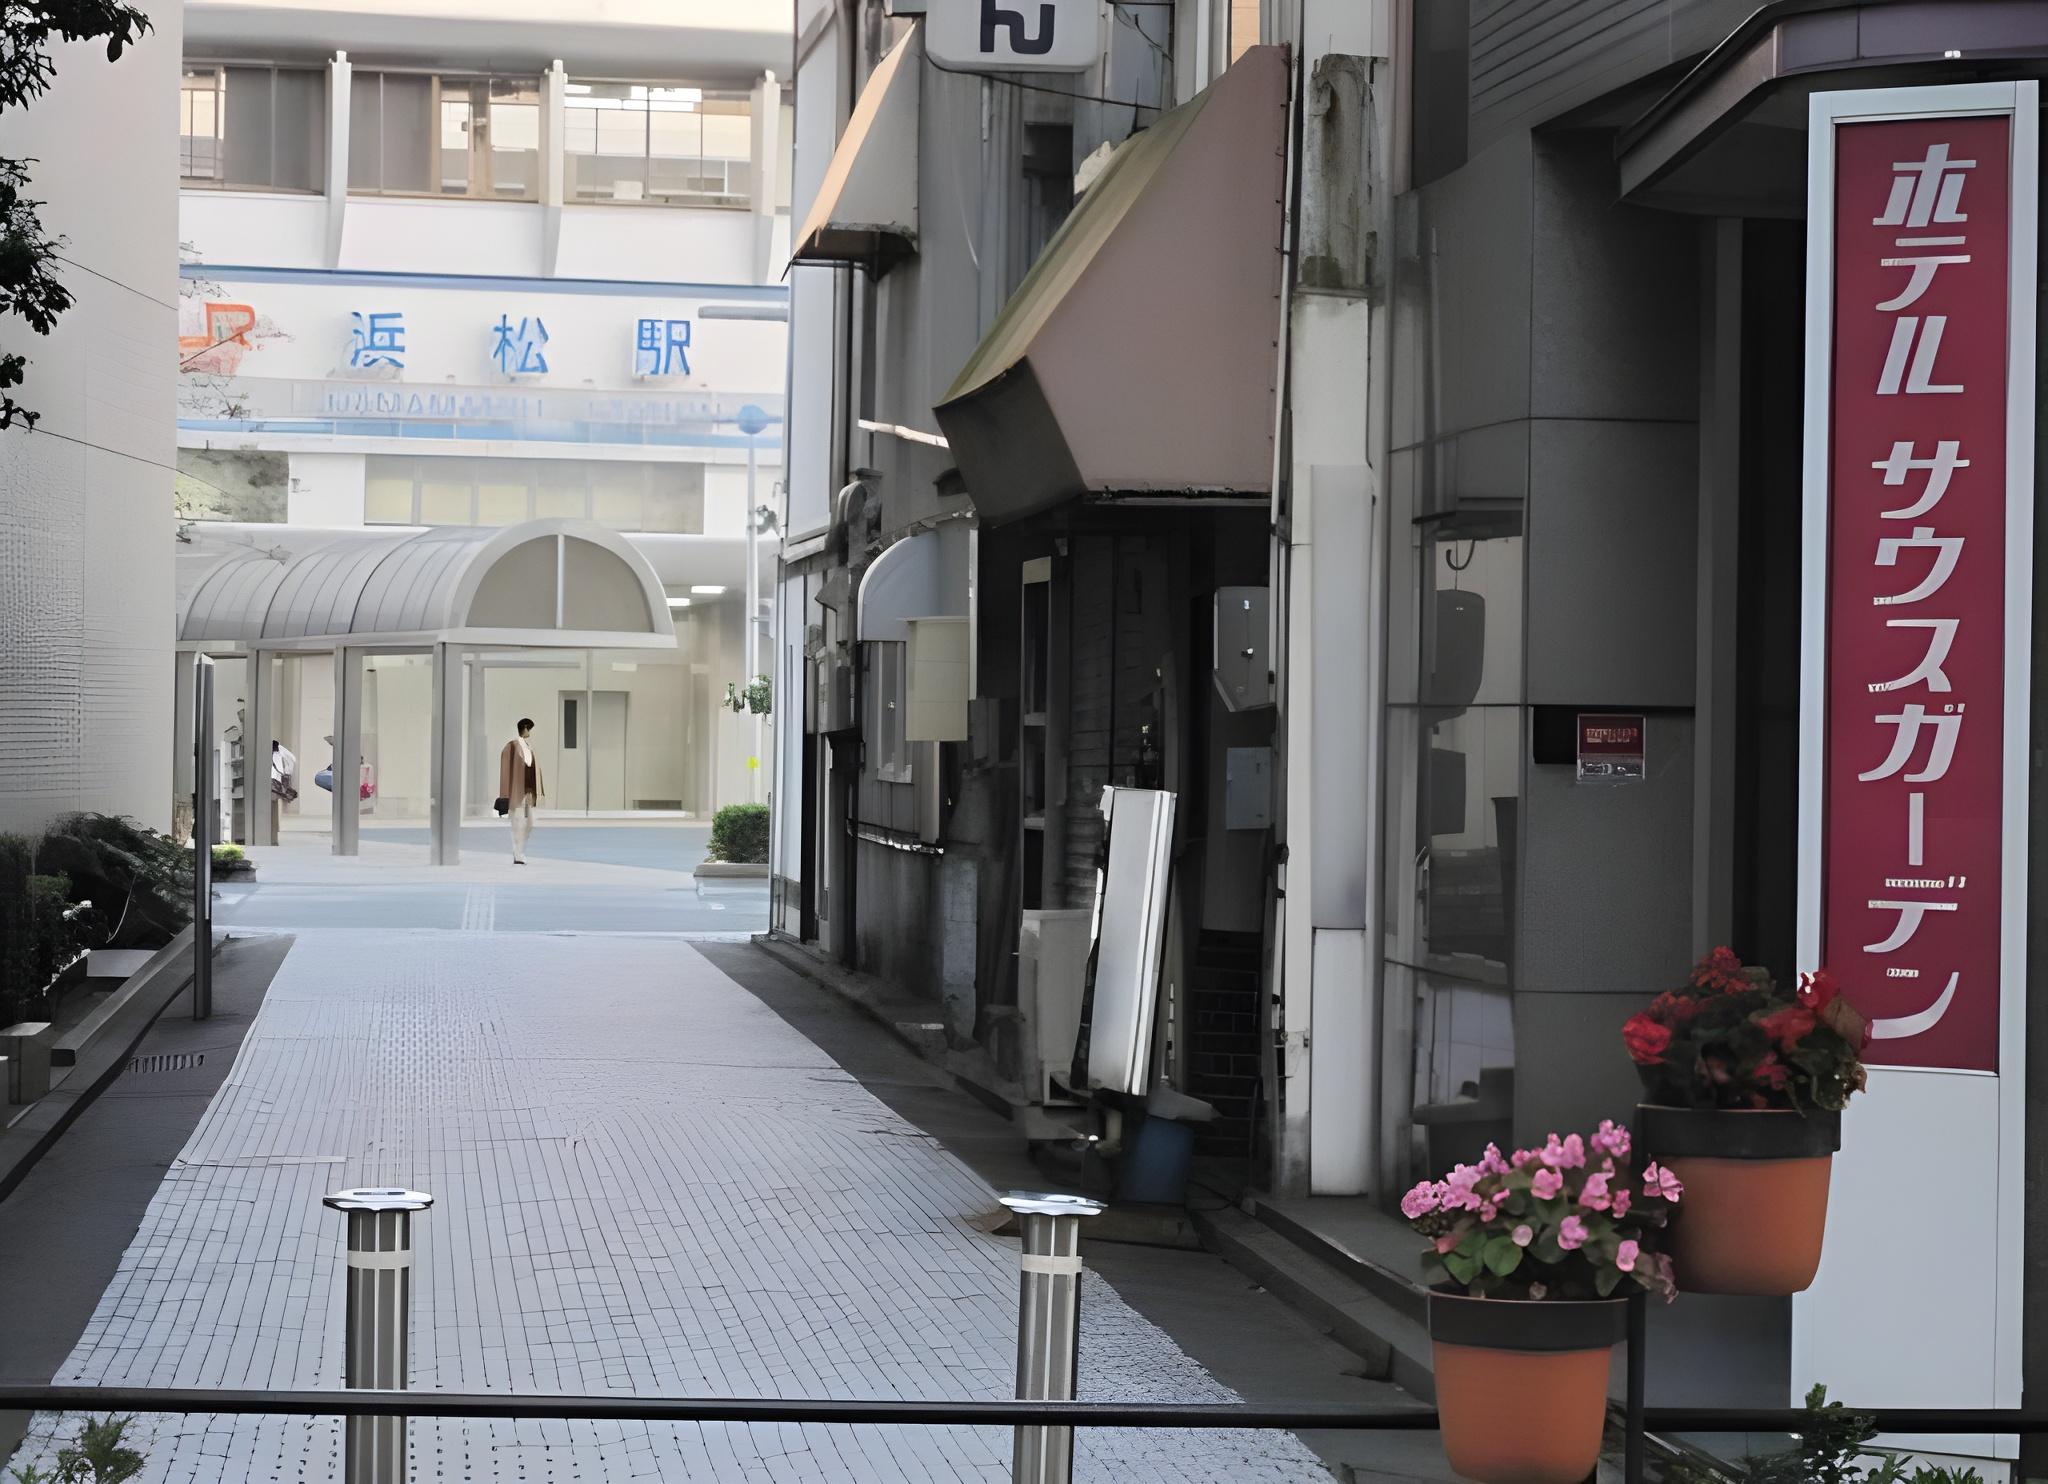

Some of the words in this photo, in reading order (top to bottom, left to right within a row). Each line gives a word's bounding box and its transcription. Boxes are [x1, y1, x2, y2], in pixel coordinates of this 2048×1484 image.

[350, 311, 691, 376] 浜松駅
[1872, 143, 1977, 394] ホテル
[1858, 440, 1970, 1040] サウスガーデン
